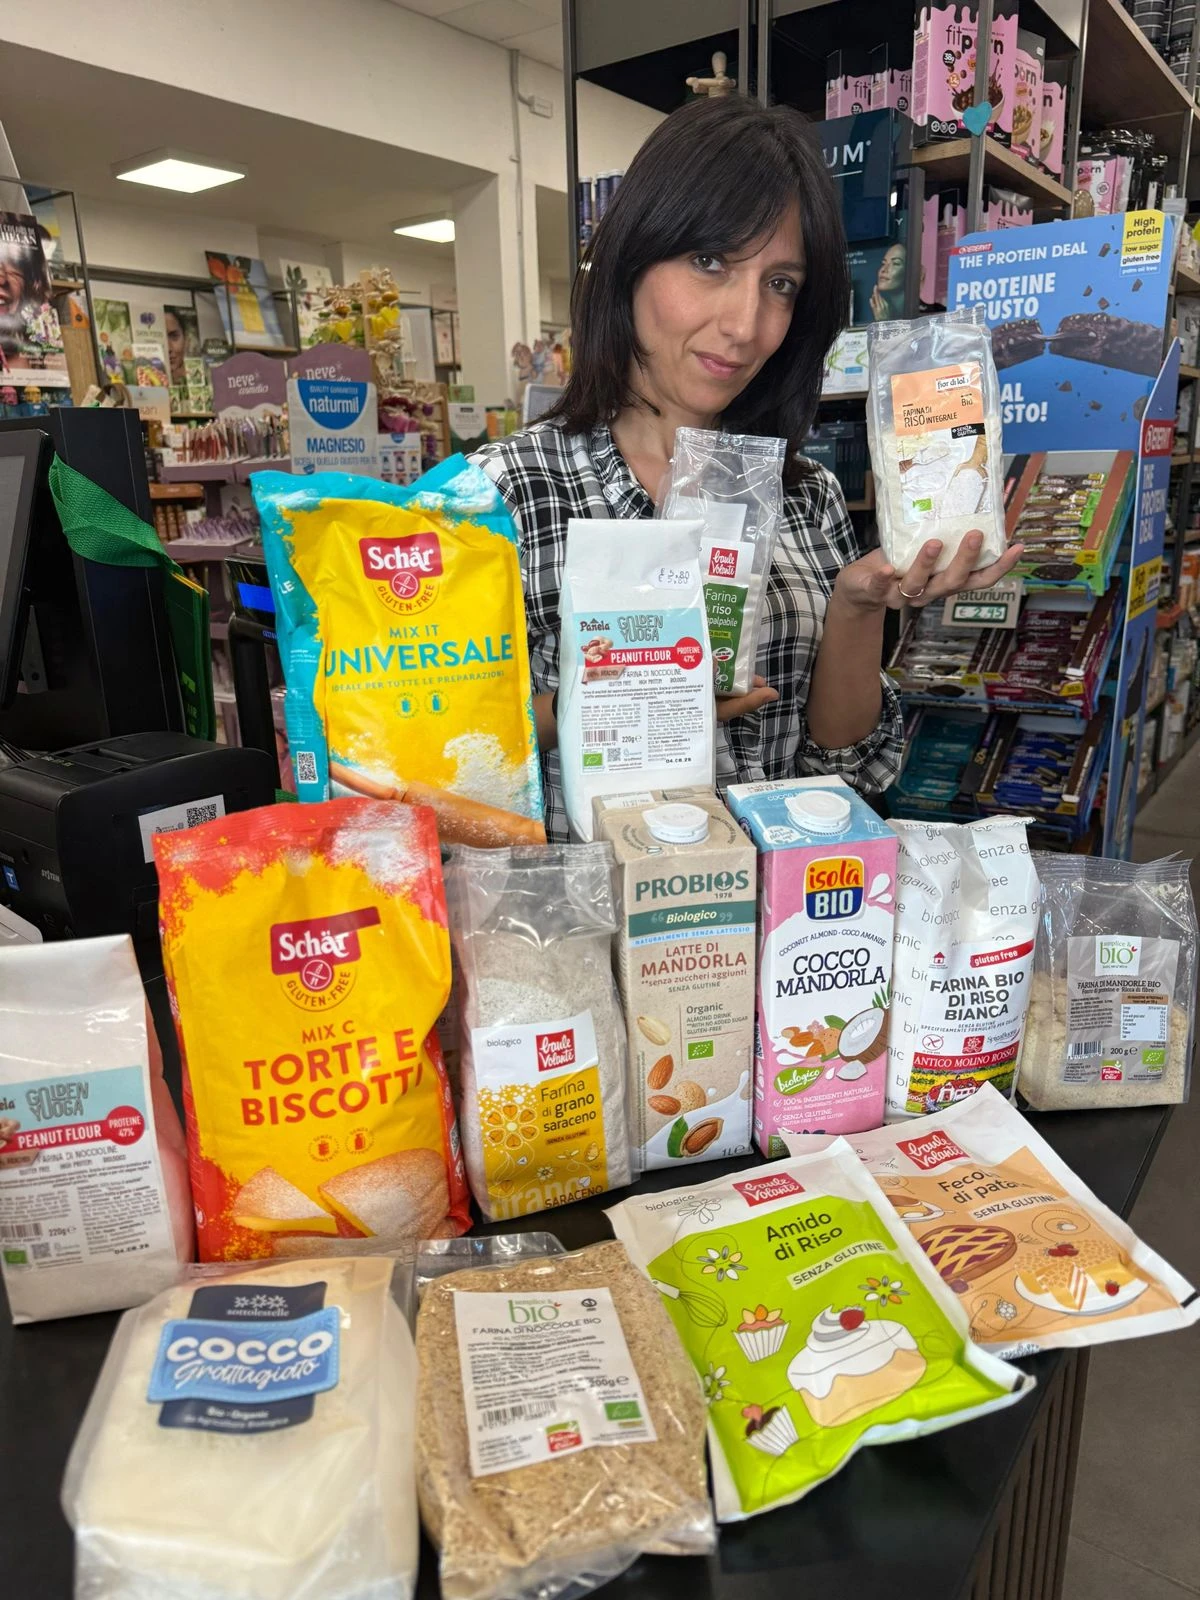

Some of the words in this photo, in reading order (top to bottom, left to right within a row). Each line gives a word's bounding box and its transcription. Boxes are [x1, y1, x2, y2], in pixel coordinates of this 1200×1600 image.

[1126, 226, 1160, 238] protein
[1134, 218, 1155, 228] High
[960, 256, 986, 269] THE
[987, 247, 1047, 266] PROTEIN
[1052, 241, 1088, 259] DEAL
[1122, 255, 1144, 264] gluten
[956, 272, 1056, 302] PROTEINE
[228, 374, 255, 388] neve
[306, 365, 337, 380] neve
[309, 396, 359, 414] naturmil
[904, 415, 925, 428] RISO
[926, 412, 958, 424] INTEGRALE
[307, 438, 365, 454] MAGNESIO
[367, 546, 434, 572] Schär
[378, 583, 434, 611] GLUTEN-FREE
[705, 588, 737, 603] Farina
[712, 603, 732, 615] riso
[389, 626, 419, 638] MIX
[426, 624, 439, 636] IT
[325, 633, 513, 678] UNIVERSALE
[611, 652, 642, 663] PEANUT
[645, 651, 671, 662] FLOUR
[677, 647, 700, 655] PROTEINE
[331, 682, 362, 693] IDEALE
[364, 681, 383, 690] PER
[386, 679, 419, 688] TUTTE
[422, 677, 433, 685] LE
[437, 670, 505, 684] PREPARAZIONI
[635, 870, 749, 902] PROBIOS
[809, 860, 860, 890] isola
[814, 890, 853, 918] BIO
[666, 910, 717, 924] Biologico
[279, 930, 350, 962] Schär
[635, 932, 689, 945] NATURALMENTE
[691, 929, 714, 937] SENZA
[779, 936, 809, 957] COCONUT
[809, 929, 838, 941] ALMOND
[860, 930, 887, 948] AMANDE
[666, 943, 702, 958] LATTE
[706, 942, 719, 952] DI
[974, 954, 1000, 967] gluten
[1000, 950, 1018, 961] free
[1100, 941, 1133, 964] bio
[641, 952, 747, 978] MANDORLA
[792, 948, 871, 975] COCCO
[668, 985, 690, 993] SENZA
[691, 981, 720, 990] GLUTINE
[674, 973, 710, 984] zuccheri
[711, 969, 747, 979] aggiunti
[775, 966, 886, 998] MANDORLA
[930, 975, 990, 994] FARINA
[995, 971, 1025, 987] BIO
[286, 971, 351, 1007] GLUTEN-FREE
[948, 994, 965, 1008] DI
[970, 989, 1009, 1005] RISO
[686, 1003, 723, 1015] Organic
[944, 1004, 1009, 1021] BIANCA
[302, 1024, 336, 1044] MIX
[342, 1020, 356, 1034] C
[687, 1026, 722, 1035] GLUTEN-FREE
[714, 1018, 731, 1026] ADDED
[486, 1038, 522, 1048] biologico
[243, 1036, 381, 1090] TORTE
[394, 1028, 417, 1062] E
[914, 1056, 952, 1068] ANTICO
[954, 1055, 990, 1067] MOLINO
[992, 1047, 1015, 1063] ROSSO
[540, 1079, 585, 1102] Farina
[779, 1069, 820, 1093] biologico
[542, 1107, 552, 1118] di
[555, 1093, 595, 1118] grano
[805, 1108, 832, 1117] GLUTINE
[108, 1115, 142, 1129] PROTEINE
[118, 1127, 135, 1138] 47%
[543, 1110, 597, 1133] saraceno
[18, 1129, 63, 1149] PEANUT
[65, 1125, 102, 1143] FLOUR
[544, 1185, 603, 1209] SARACENO
[645, 1194, 695, 1212] biologico
[953, 1191, 970, 1204] di
[973, 1201, 1011, 1220] SENZA
[1013, 1194, 1057, 1210] GLUTINE
[765, 1211, 832, 1242] Amido
[774, 1243, 795, 1261] di
[796, 1225, 843, 1253] Riso
[792, 1259, 832, 1286] SENZA
[833, 1241, 886, 1265] GLUTINE
[508, 1300, 559, 1324] bio
[472, 1327, 512, 1335] FARINA
[514, 1326, 524, 1334] DI
[524, 1319, 581, 1333] NOCCIOLE
[583, 1317, 602, 1325] BIO
[166, 1330, 334, 1365] COCCO
[174, 1357, 320, 1390] Grattugiato
